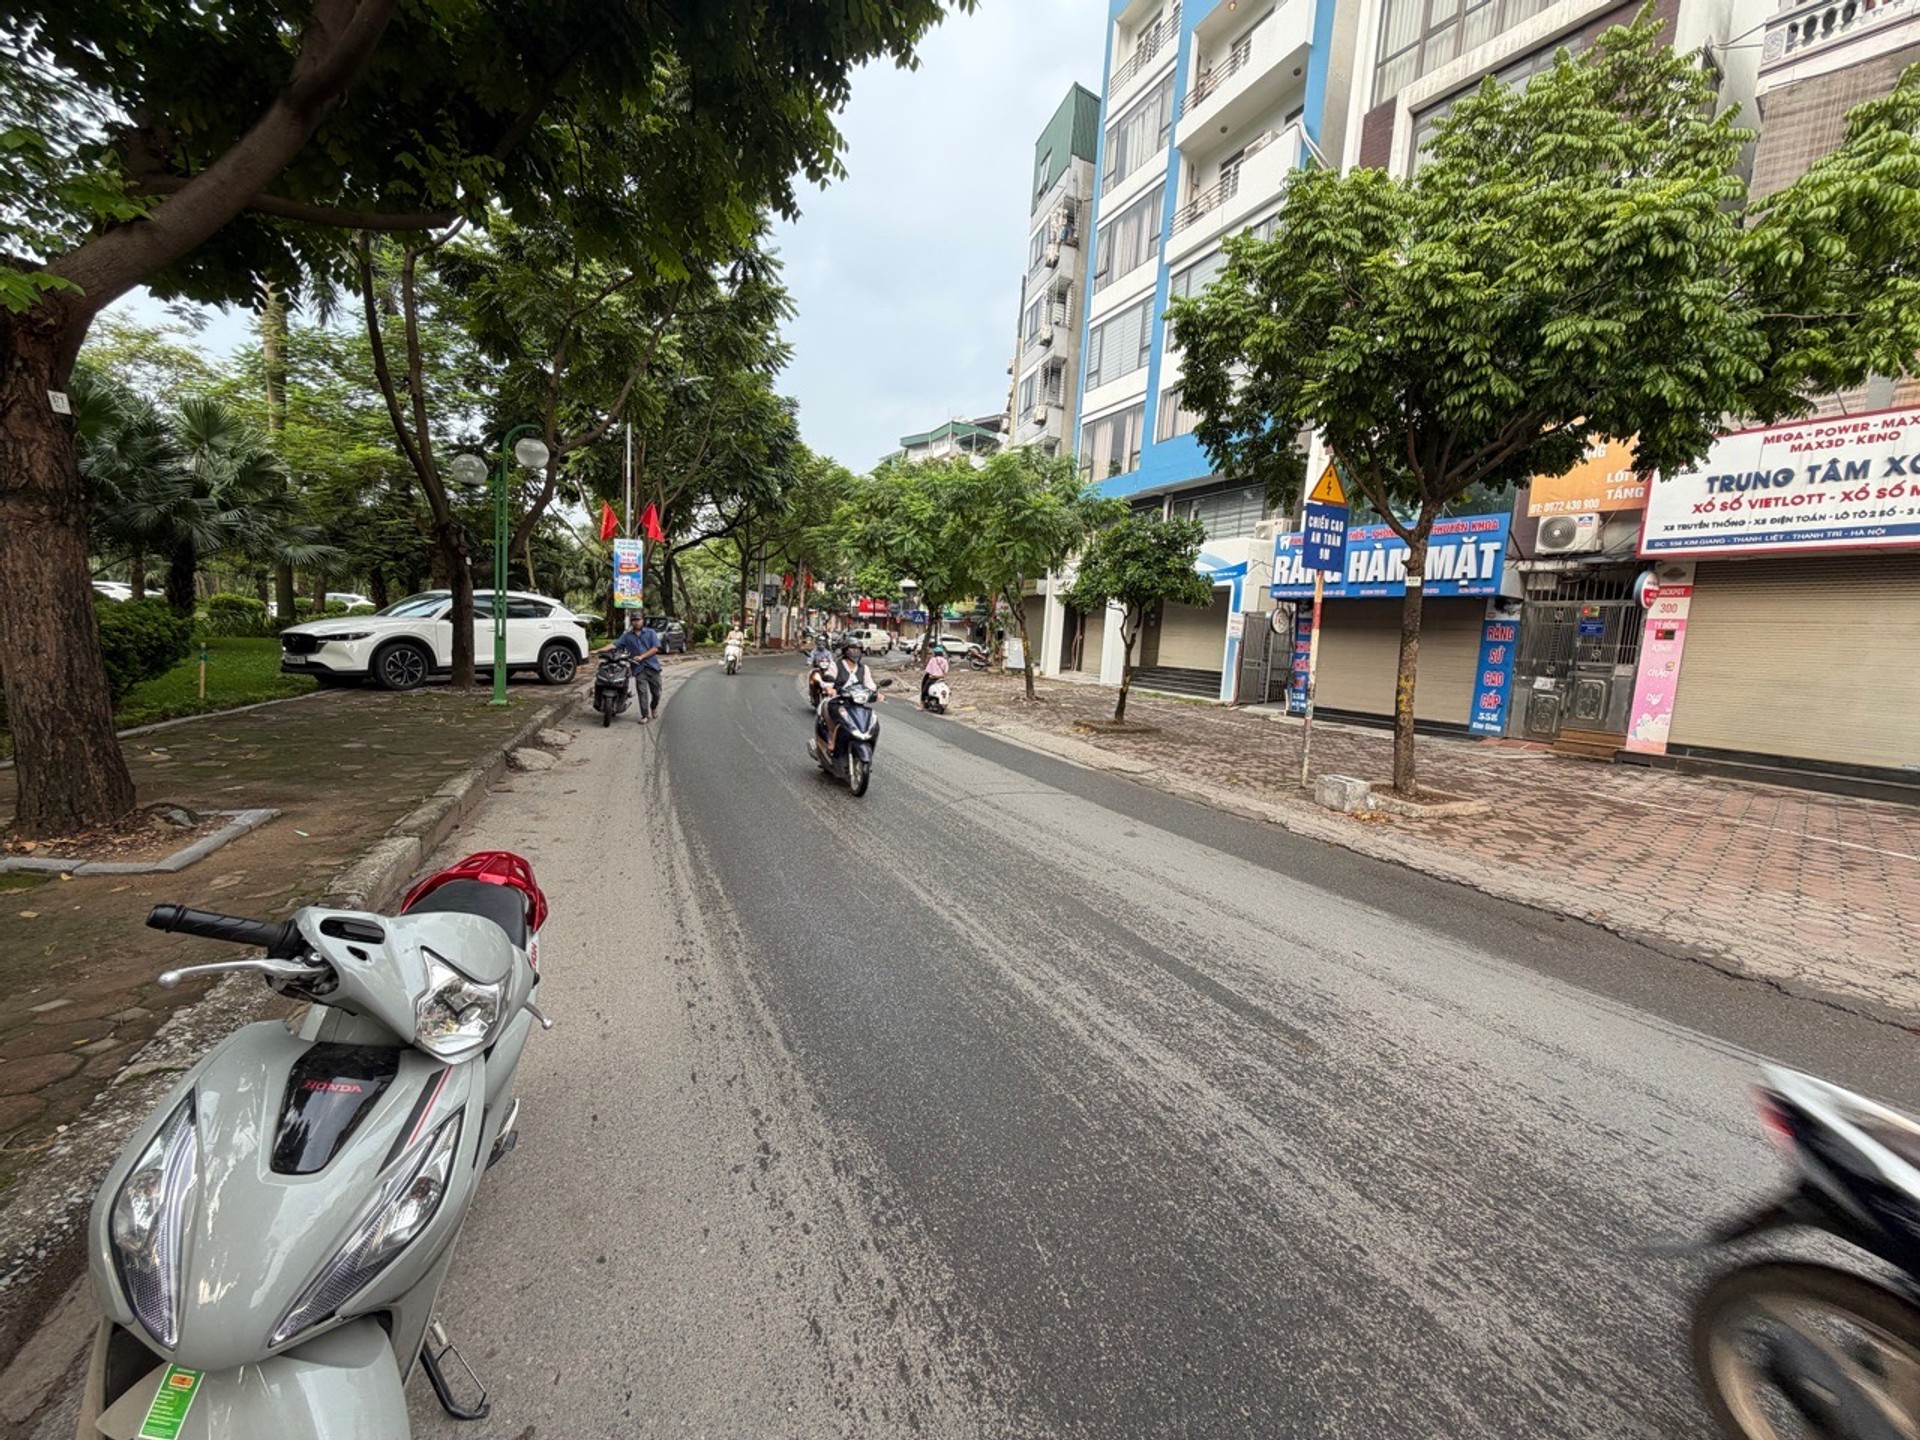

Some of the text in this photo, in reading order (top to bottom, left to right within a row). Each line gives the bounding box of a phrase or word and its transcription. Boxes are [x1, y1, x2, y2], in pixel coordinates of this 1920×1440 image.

[1763, 415, 1920, 445] MEGA POWER MAX
[1790, 430, 1901, 453] MAX3D KENO
[1707, 467, 1795, 494] TRUNG
[1807, 457, 1871, 484] TÂM
[1692, 497, 1716, 514] XỔ
[1719, 494, 1744, 513] SỐ
[1748, 493, 1826, 509] VIETLOTT
[1840, 482, 1870, 503] XỔ
[1876, 480, 1906, 499] SỐ
[1712, 517, 1746, 529] THỐNG
[1796, 512, 1827, 523] TOÁN
[1699, 537, 1727, 546] GIANG
[1733, 535, 1763, 543] THANH
[1793, 532, 1824, 541] THANH
[1850, 528, 1866, 537] HÀ
[1423, 536, 1502, 586] MẶT
[1659, 603, 1679, 614] 300
[1486, 624, 1515, 642] RĂNG
[301, 1080, 363, 1094] HONDA
